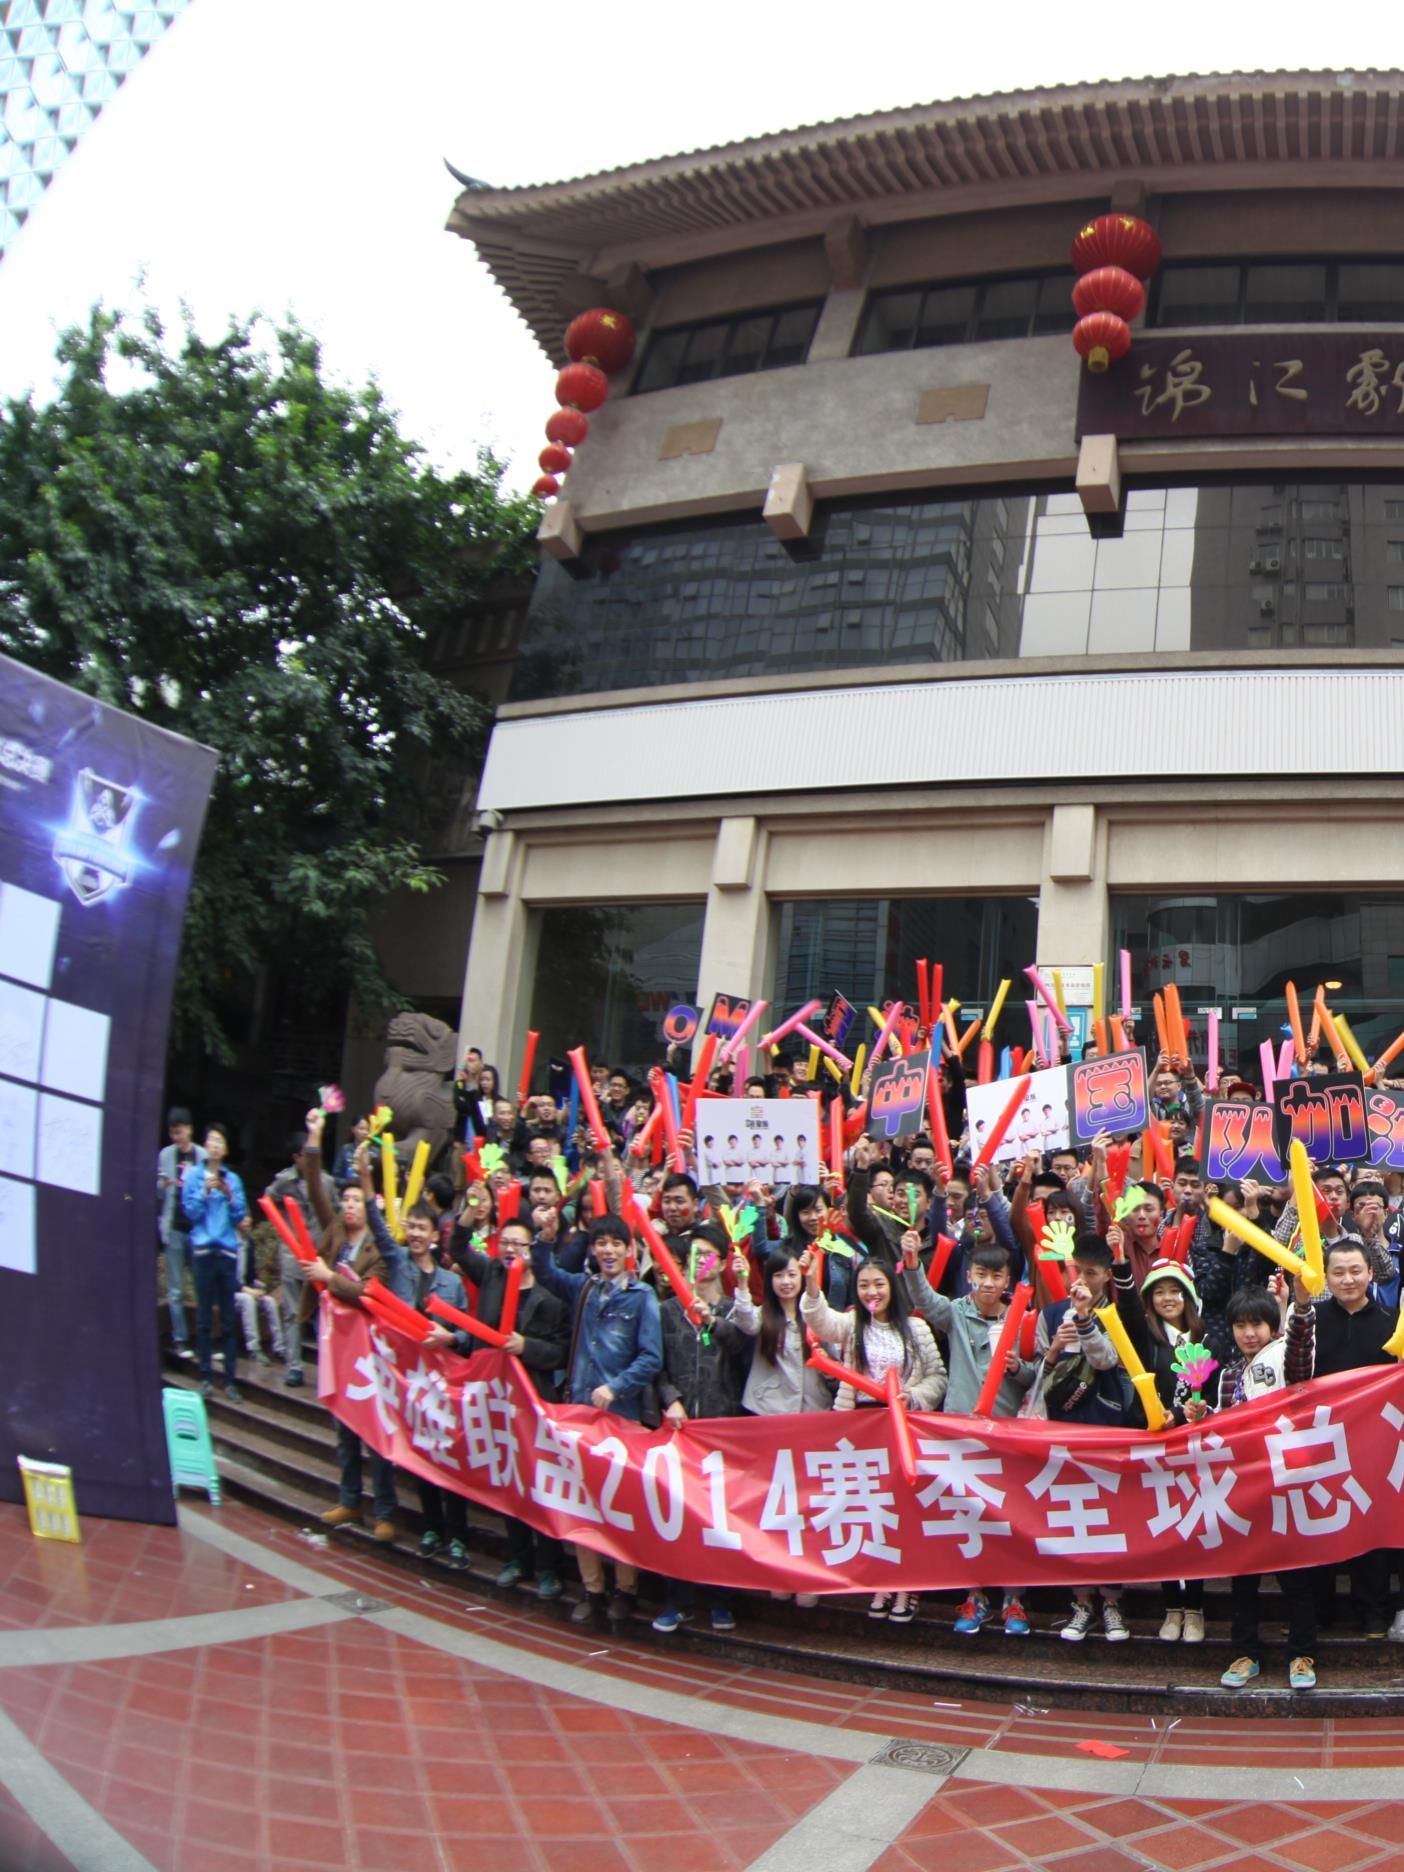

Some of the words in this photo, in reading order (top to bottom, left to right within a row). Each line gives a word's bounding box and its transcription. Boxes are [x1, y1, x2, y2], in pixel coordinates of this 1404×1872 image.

[663, 1004, 698, 1044] O
[709, 995, 750, 1037] M
[870, 1058, 925, 1136] 中
[1074, 1052, 1146, 1138] 国
[1280, 1081, 1368, 1163] 加
[1207, 1103, 1287, 1182] 队
